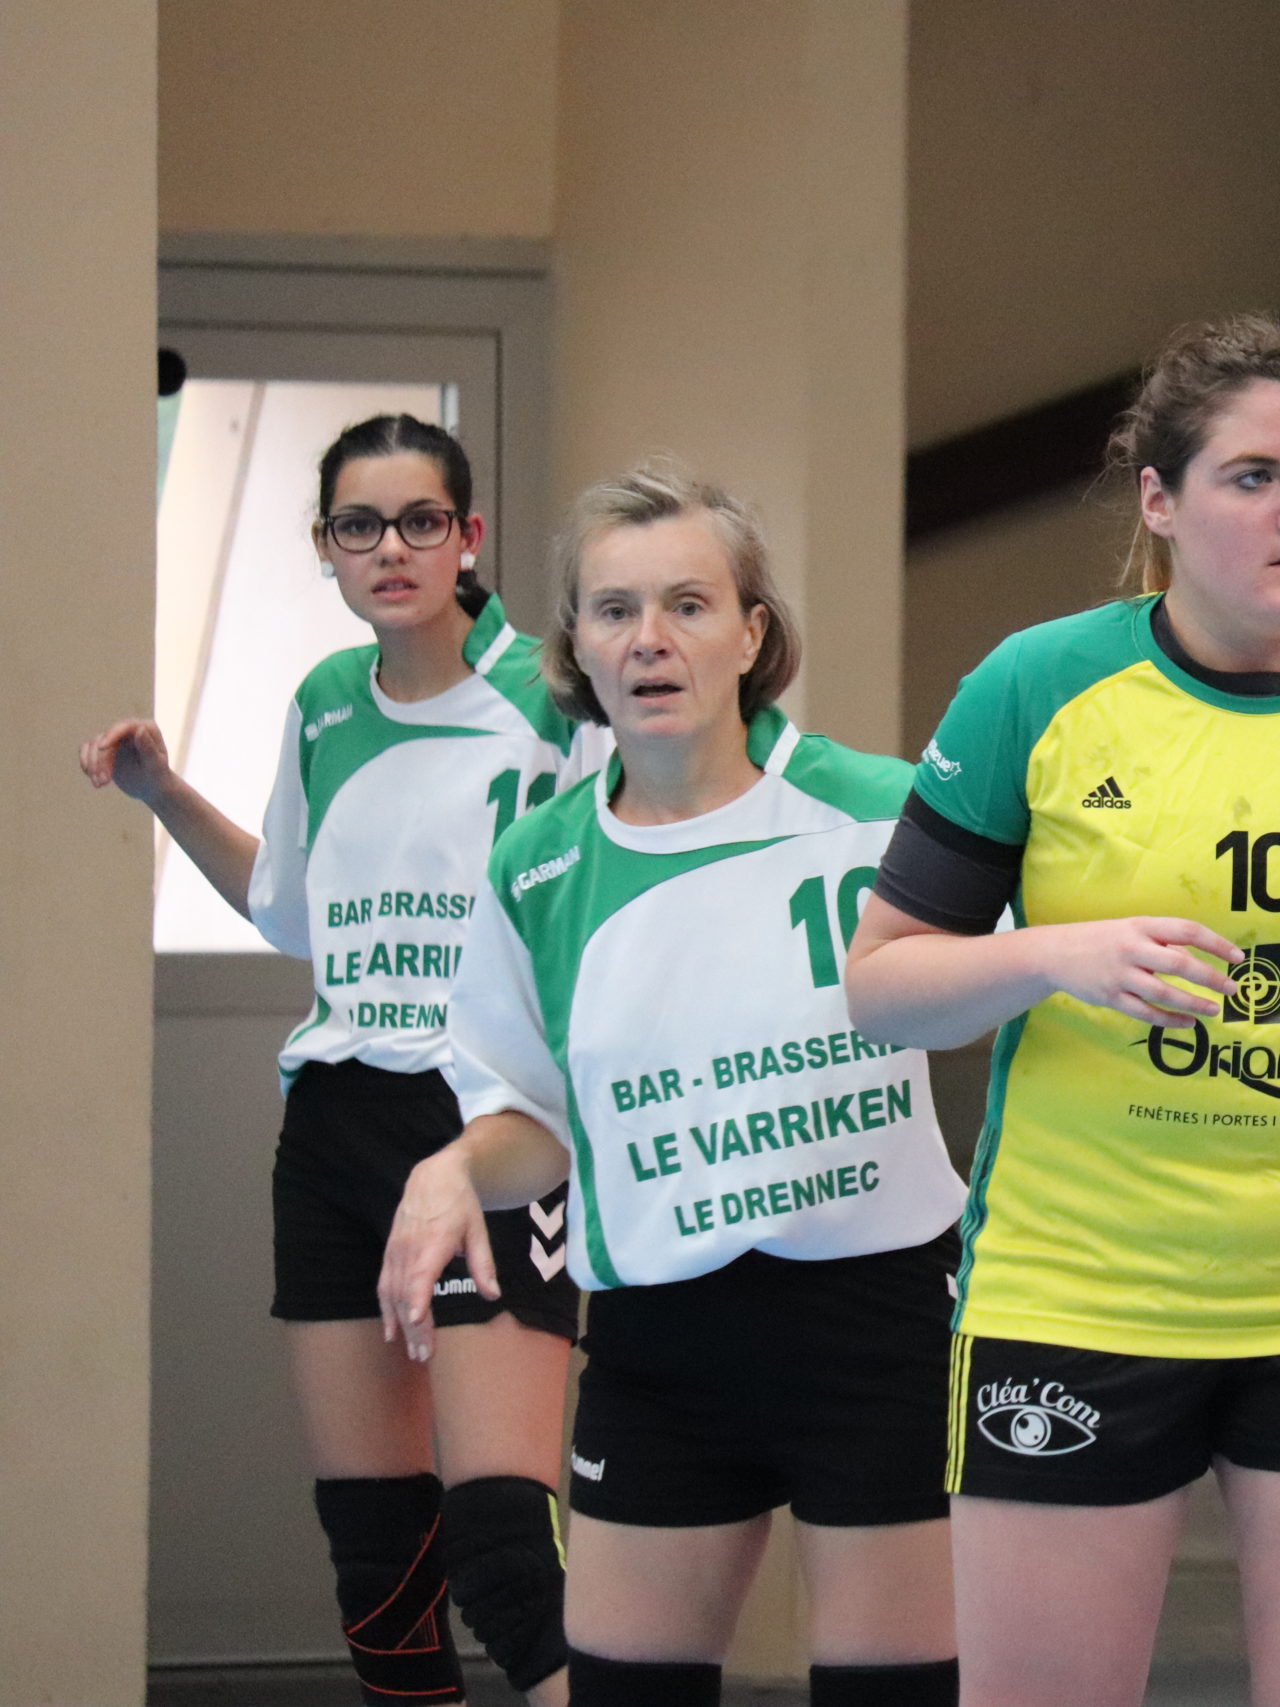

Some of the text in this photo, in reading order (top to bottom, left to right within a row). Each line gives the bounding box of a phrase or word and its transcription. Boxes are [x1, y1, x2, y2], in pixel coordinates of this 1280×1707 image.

[1082, 797, 1132, 810] adidas
[327, 891, 476, 928] BAR BRASS
[325, 951, 362, 986] LE
[611, 1068, 685, 1113] BAR
[712, 1029, 908, 1090] BRASSER
[627, 1079, 913, 1183] LE VARRIKEN
[1128, 1104, 1199, 1124] FENÊTRES
[1212, 1113, 1268, 1127] PORTES
[674, 1160, 880, 1237] LE DRENNEC
